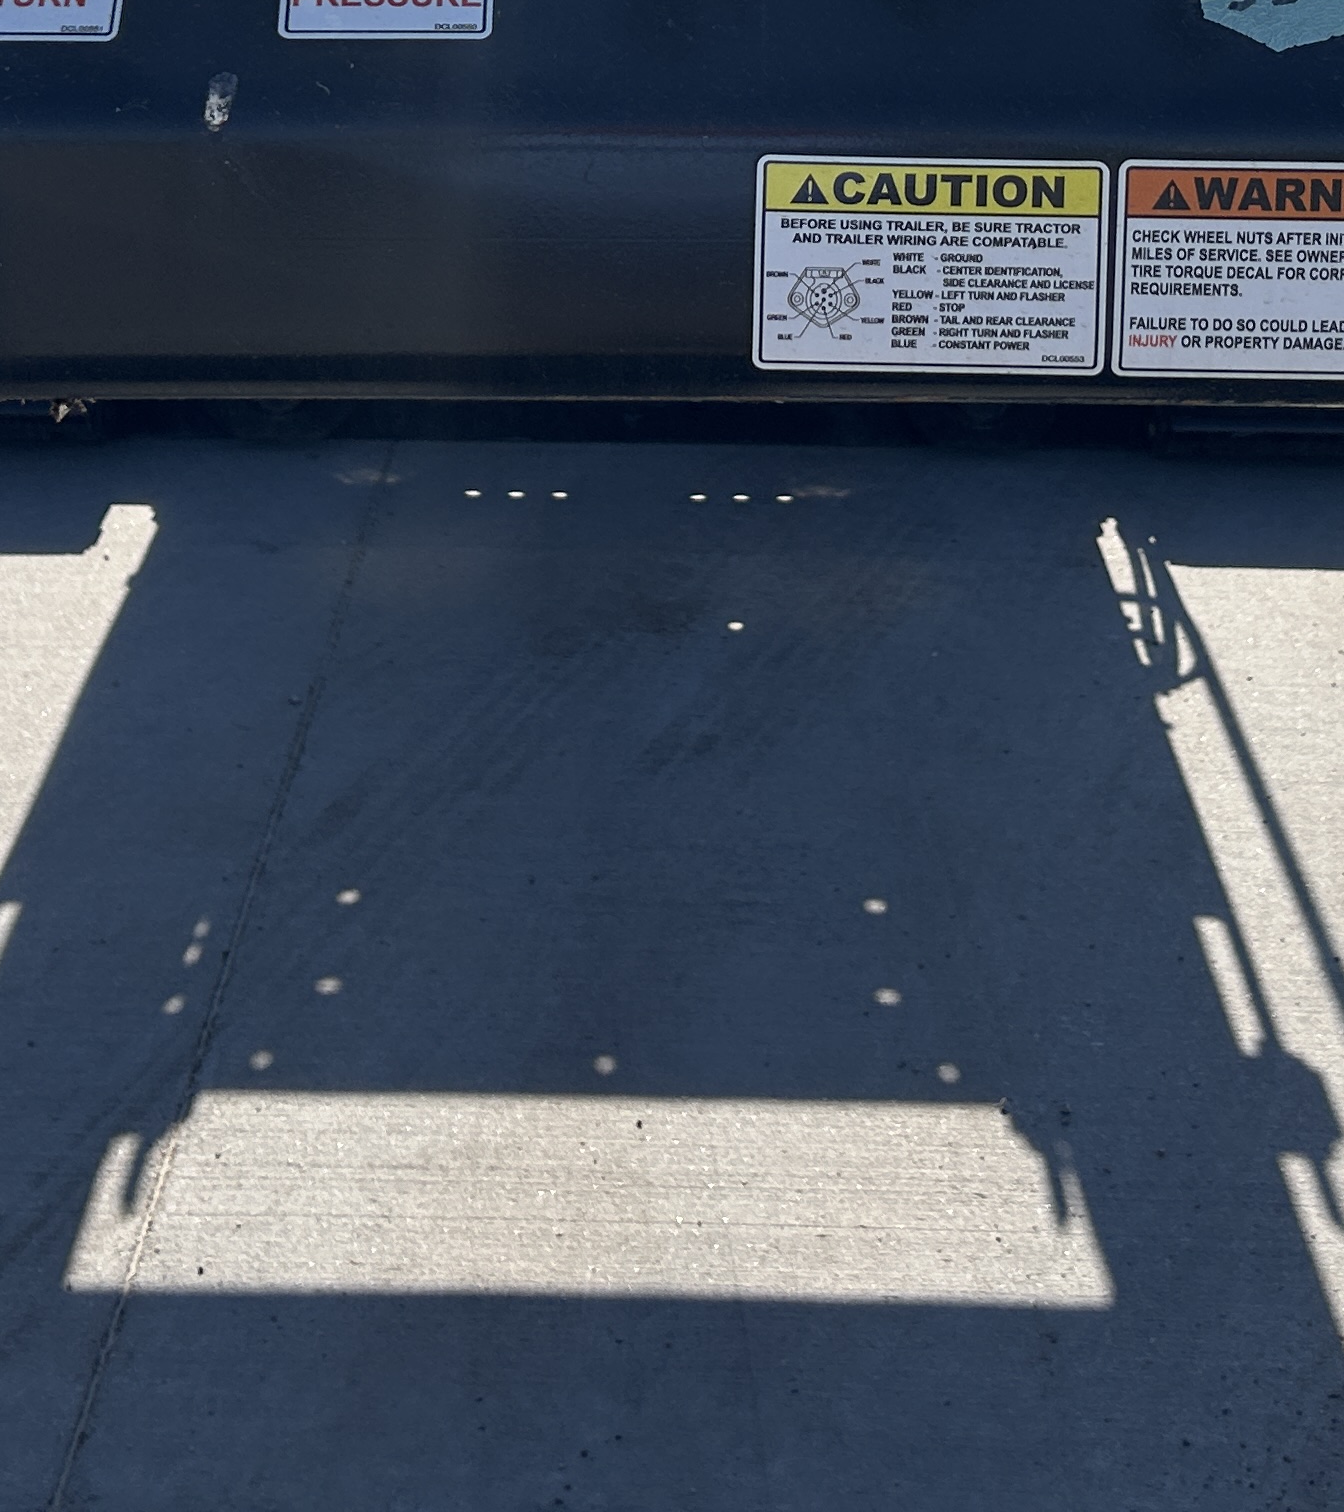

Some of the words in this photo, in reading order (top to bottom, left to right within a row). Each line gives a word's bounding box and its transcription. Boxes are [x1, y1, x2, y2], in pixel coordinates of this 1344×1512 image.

[833, 172, 1065, 208] CAUTION
[781, 218, 836, 229] BEFORE
[841, 220, 882, 230] USING
[886, 221, 947, 233] TRAILER,
[952, 222, 970, 232] BE
[975, 222, 1011, 233] SURE
[1015, 223, 1080, 234] TRACTOR
[793, 233, 821, 243] AND
[826, 234, 883, 245] TRAILER
[887, 235, 936, 246] WIRING
[940, 236, 968, 246] ARE
[1133, 230, 1180, 243] CHECK
[1184, 230, 1232, 244] WHEEL
[1237, 232, 1272, 244] NUTS
[1276, 232, 1321, 245] AFTER
[893, 253, 924, 262] WHITE
[940, 253, 983, 263] GROUND
[1132, 247, 1172, 260] MILES
[1177, 248, 1195, 261] OF
[1199, 249, 1261, 262] SERVICE.
[1266, 250, 1292, 262] SEE
[893, 265, 926, 274] BLACK
[943, 266, 982, 275] CENTER
[1131, 265, 1161, 277] TIRE
[1165, 265, 1222, 279] TORQUE
[1227, 267, 1273, 279] DECAL
[1277, 267, 1305, 280] FOR
[943, 278, 965, 287] SIDE
[968, 279, 1027, 288] CLEARANCE
[1030, 280, 1051, 289] AND
[1054, 280, 1094, 290] LICENSE
[1131, 282, 1242, 297] REQUIREMENTS.
[892, 289, 933, 299] YELLOW
[942, 291, 965, 300] LEFT
[968, 291, 994, 300] TURN
[996, 292, 1017, 300] AND
[1020, 292, 1065, 302] FLASHER
[892, 302, 912, 311] RED
[939, 303, 965, 312] STOP
[892, 315, 928, 324] BROWN
[940, 315, 960, 324] TAIL
[962, 316, 983, 325] AND
[986, 316, 1013, 325] REAR
[1015, 317, 1075, 327] CLEARANCE
[1130, 317, 1186, 330] FAILURE
[1190, 318, 1208, 331] TO
[1213, 319, 1232, 331] DO
[1236, 319, 1255, 332] SO
[1260, 319, 1307, 332] COULD
[891, 327, 925, 336] GREEN
[939, 328, 969, 337] RIGHT
[972, 329, 998, 337] TURN
[1000, 329, 1021, 338] AND
[1023, 329, 1068, 339] FLASHER
[891, 339, 917, 348] BLUE
[939, 340, 991, 349] CONSTANT
[994, 341, 1029, 350] POWER
[1129, 335, 1177, 347] INJURY
[1181, 335, 1201, 348] OR
[1205, 336, 1279, 349] PROPERTY
